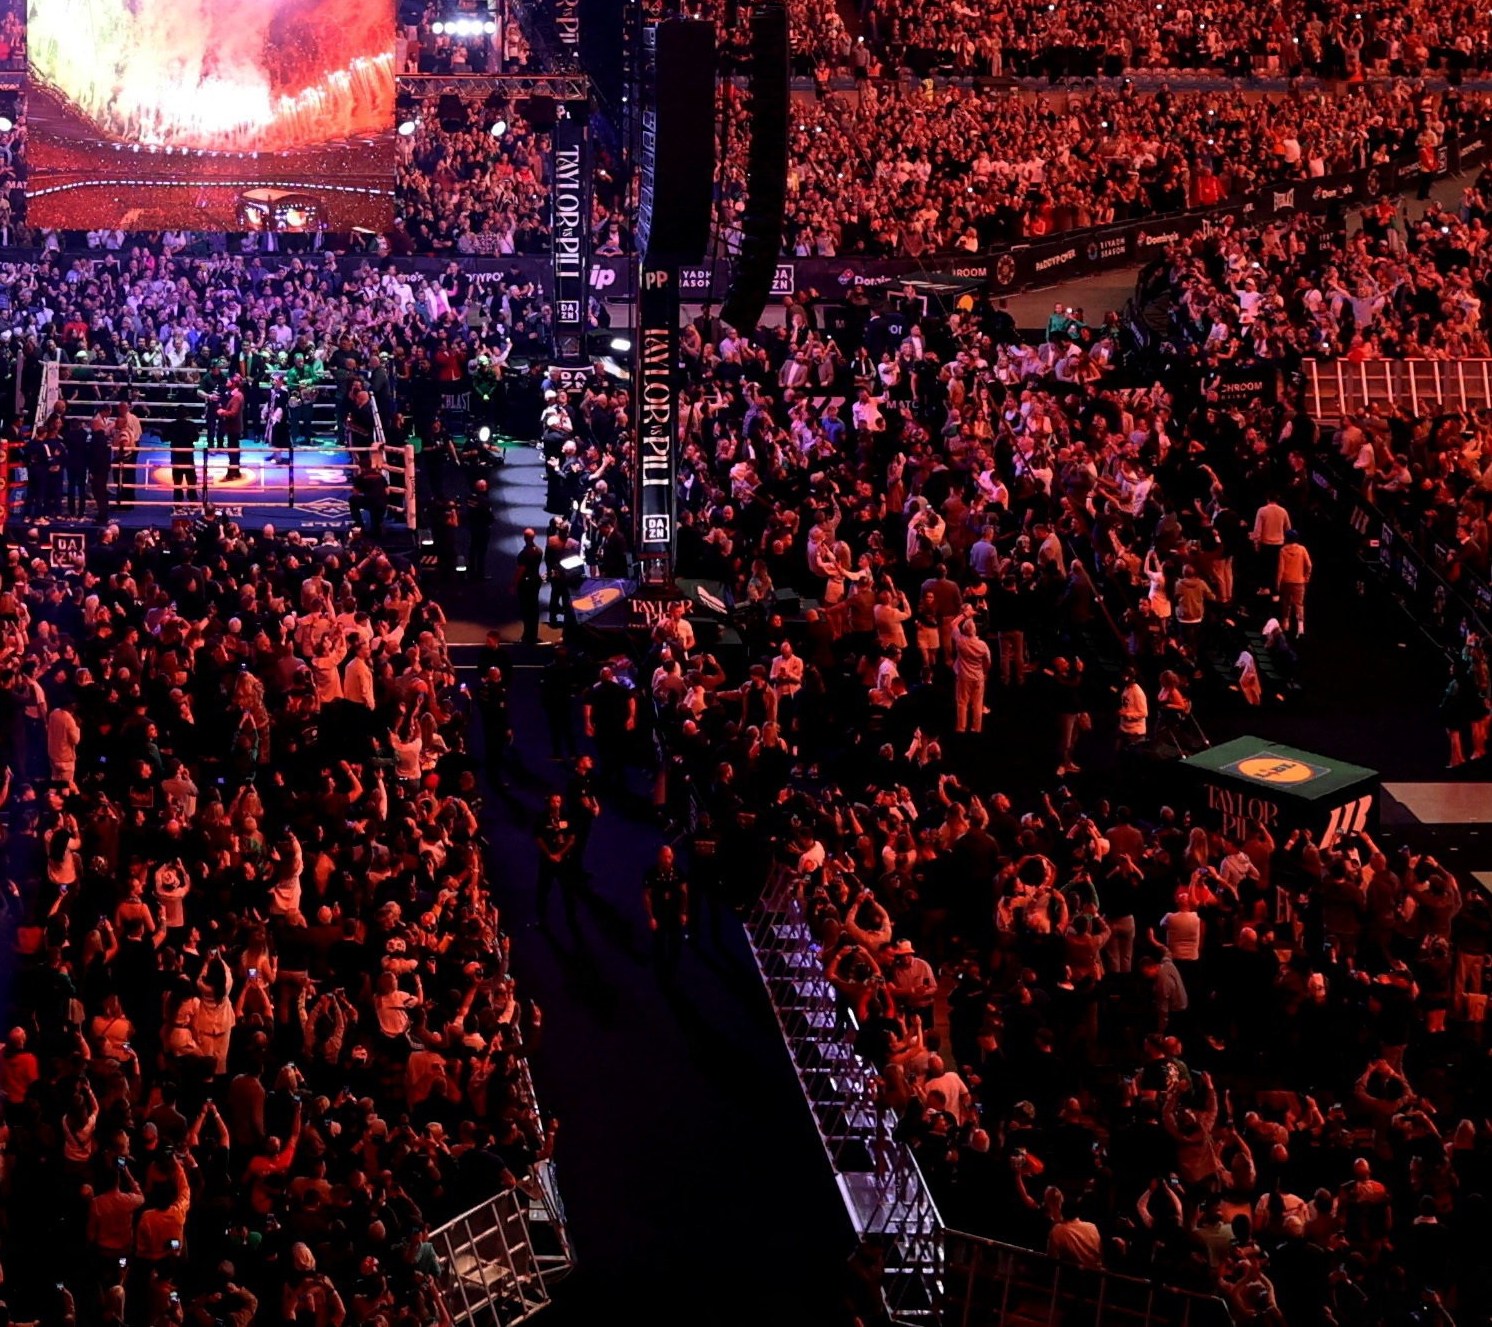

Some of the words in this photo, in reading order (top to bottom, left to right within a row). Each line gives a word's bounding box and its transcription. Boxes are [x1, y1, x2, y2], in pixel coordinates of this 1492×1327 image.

[555, 145, 579, 227] TAYLOR
[644, 329, 669, 425] TAYLOR
[649, 519, 664, 528] DA
[649, 529, 664, 538] ZN
[58, 538, 82, 551] DA
[1203, 784, 1279, 828] TAYLOR
